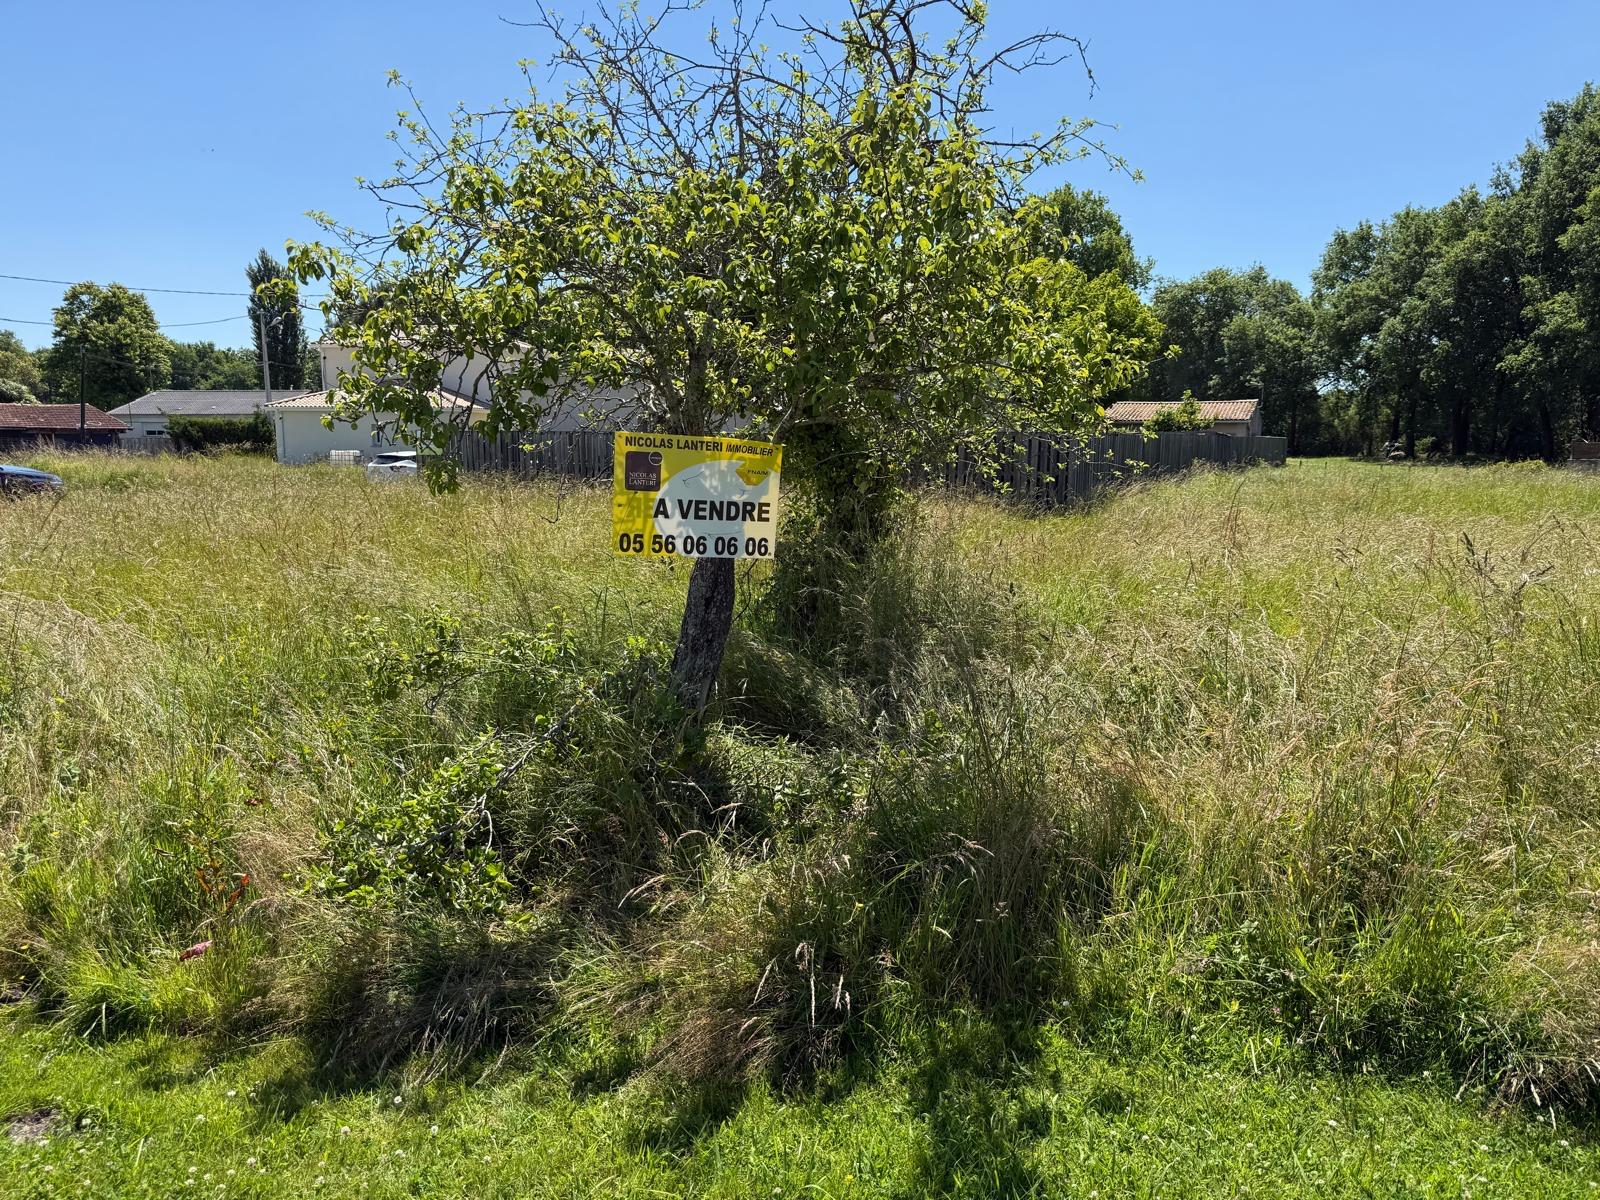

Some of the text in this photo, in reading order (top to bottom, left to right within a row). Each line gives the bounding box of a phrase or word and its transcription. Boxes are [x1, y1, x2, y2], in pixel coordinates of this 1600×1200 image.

[625, 436, 774, 456] NICOLAS LANTERI IMMOBILIER
[629, 478, 657, 486] LANTERI
[653, 498, 771, 522] A VENDRE
[619, 533, 769, 557] 05 56 06 06 06
